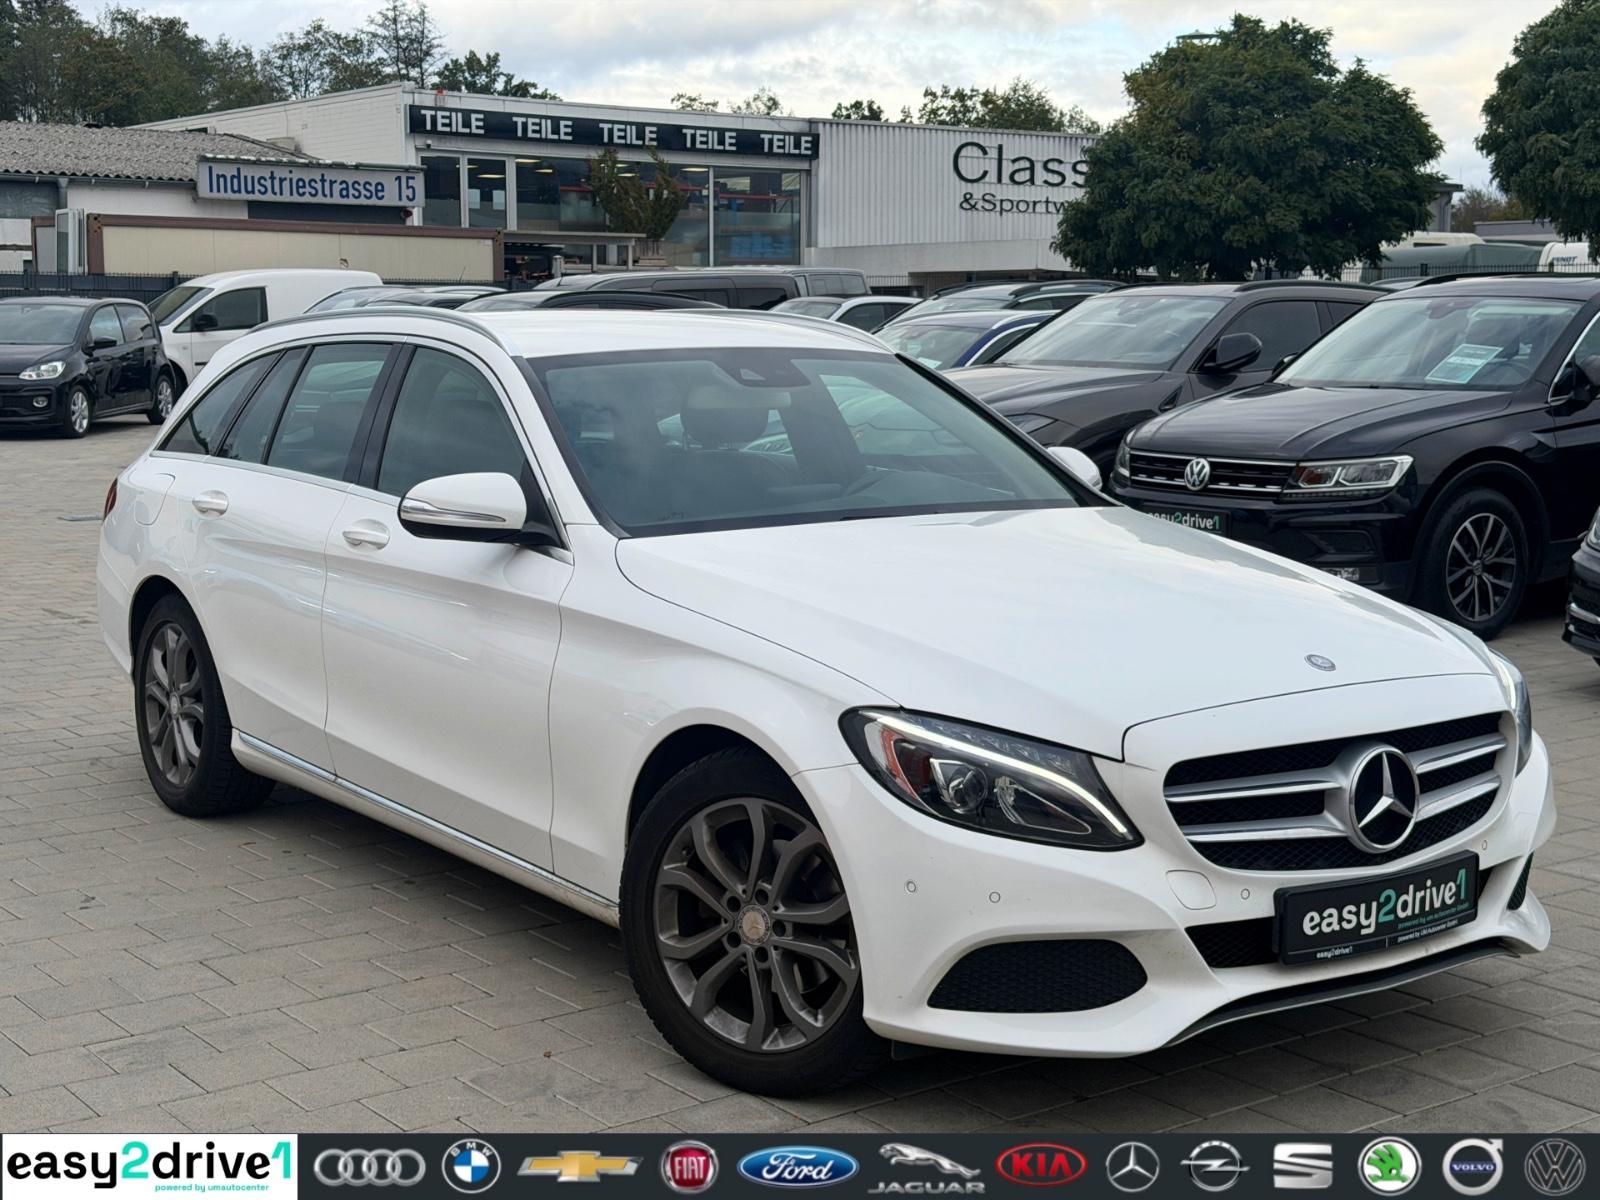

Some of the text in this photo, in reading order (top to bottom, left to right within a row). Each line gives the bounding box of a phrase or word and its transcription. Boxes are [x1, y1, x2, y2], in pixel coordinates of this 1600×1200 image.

[420, 109, 813, 155] TEILE TEILE TEILE TEILE TEILE
[208, 165, 416, 202] Industriestrasse 15
[953, 141, 1090, 188] Class
[1302, 868, 1467, 936] easy2drive1
